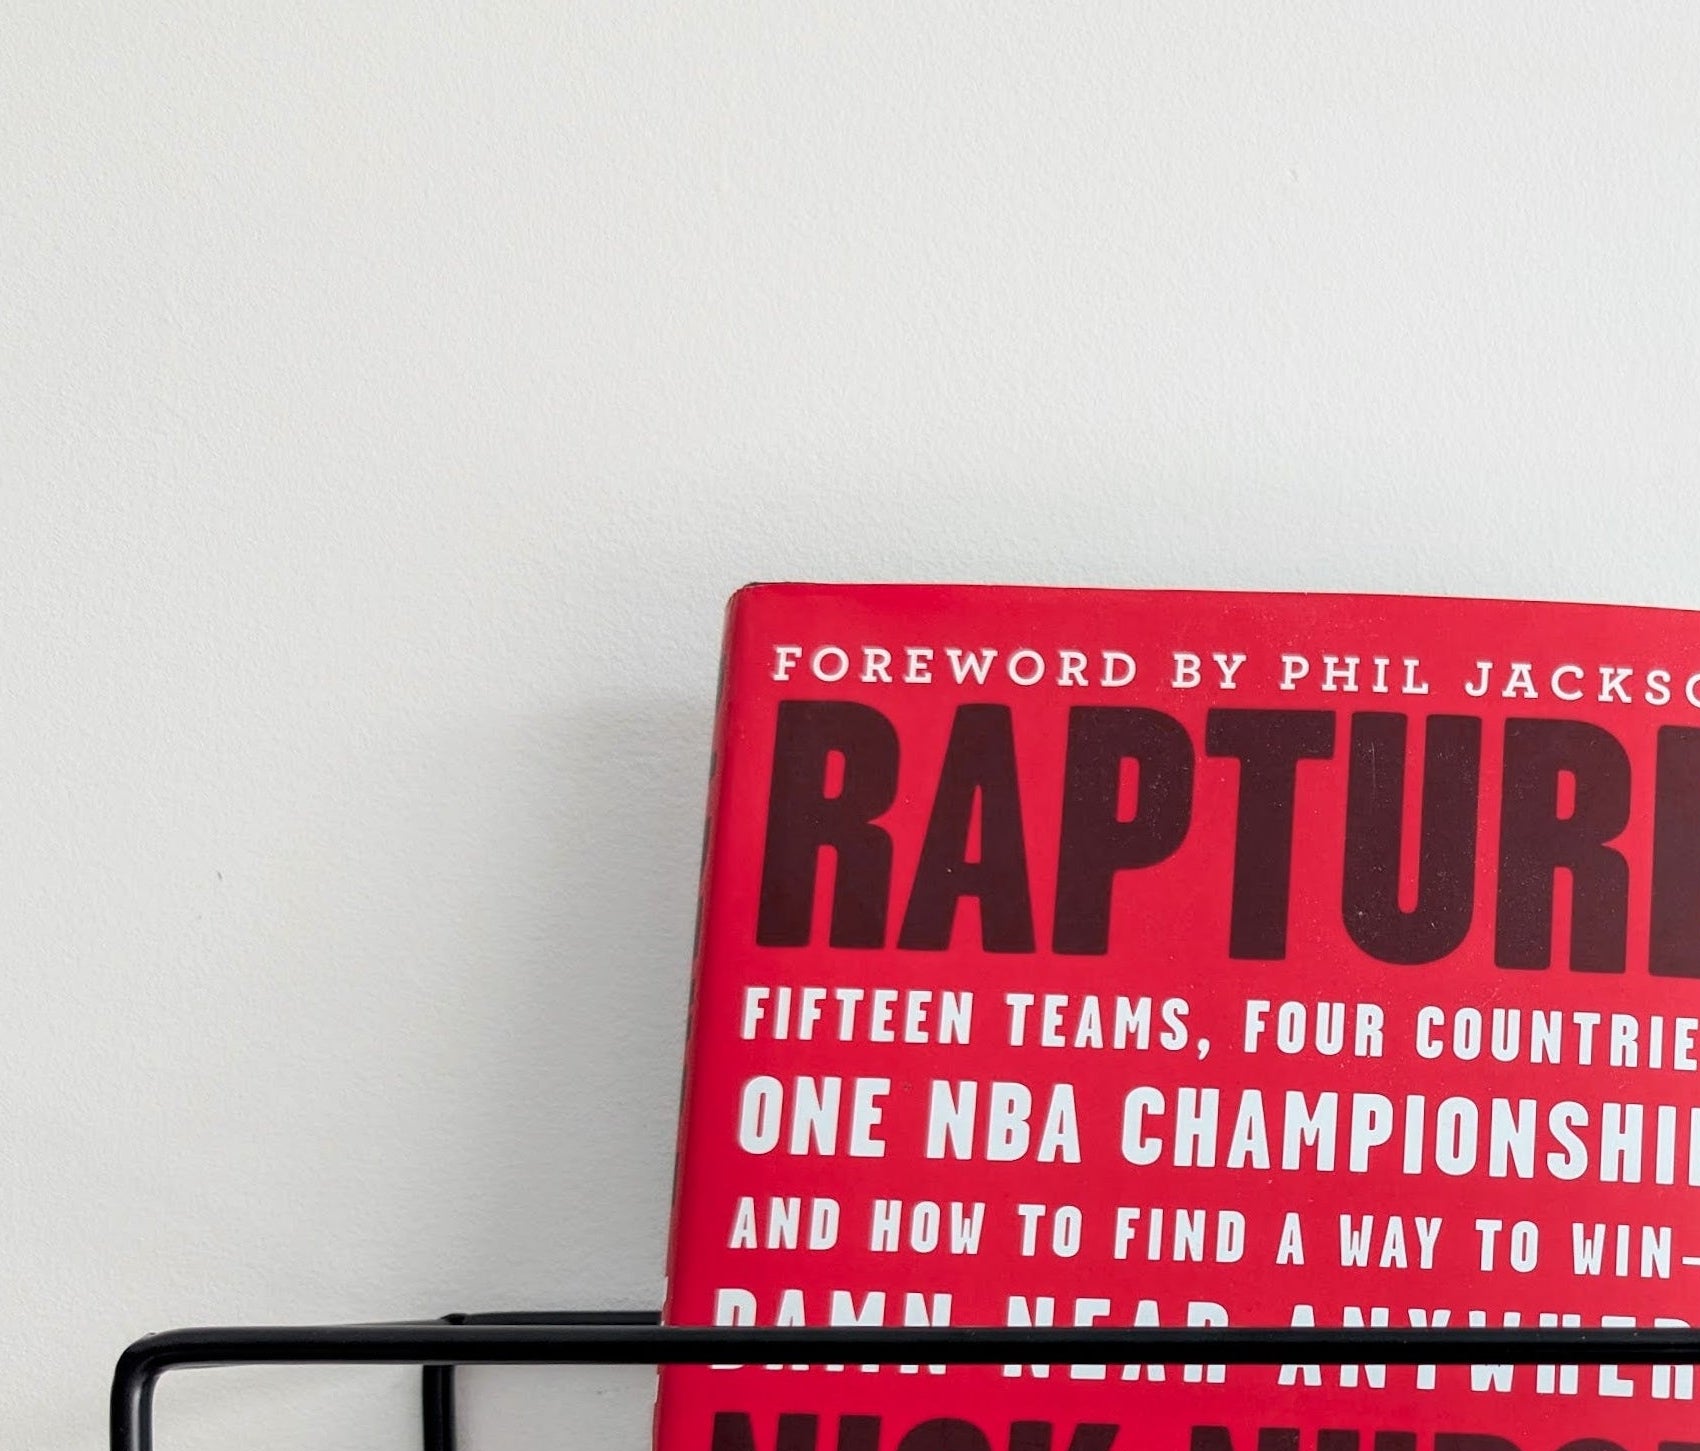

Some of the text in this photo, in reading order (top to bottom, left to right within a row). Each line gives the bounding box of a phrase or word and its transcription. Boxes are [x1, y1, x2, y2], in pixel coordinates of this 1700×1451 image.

[772, 646, 1136, 687] FOREWORD
[1171, 652, 1247, 689] BY
[1279, 654, 1429, 695] PHIL
[742, 986, 974, 1045] FIFTEEN
[1005, 992, 1210, 1060] TEAMS,
[1244, 999, 1385, 1057] FOUR
[738, 1075, 891, 1158] ONE
[926, 1079, 1081, 1164] NBA
[729, 1196, 840, 1250] AND
[870, 1199, 986, 1255] HOW
[1017, 1203, 1083, 1258] TO
[1113, 1207, 1246, 1263] FIND
[1275, 1212, 1305, 1265] A
[1339, 1214, 1443, 1270] WAY
[1475, 1218, 1539, 1273] TO
